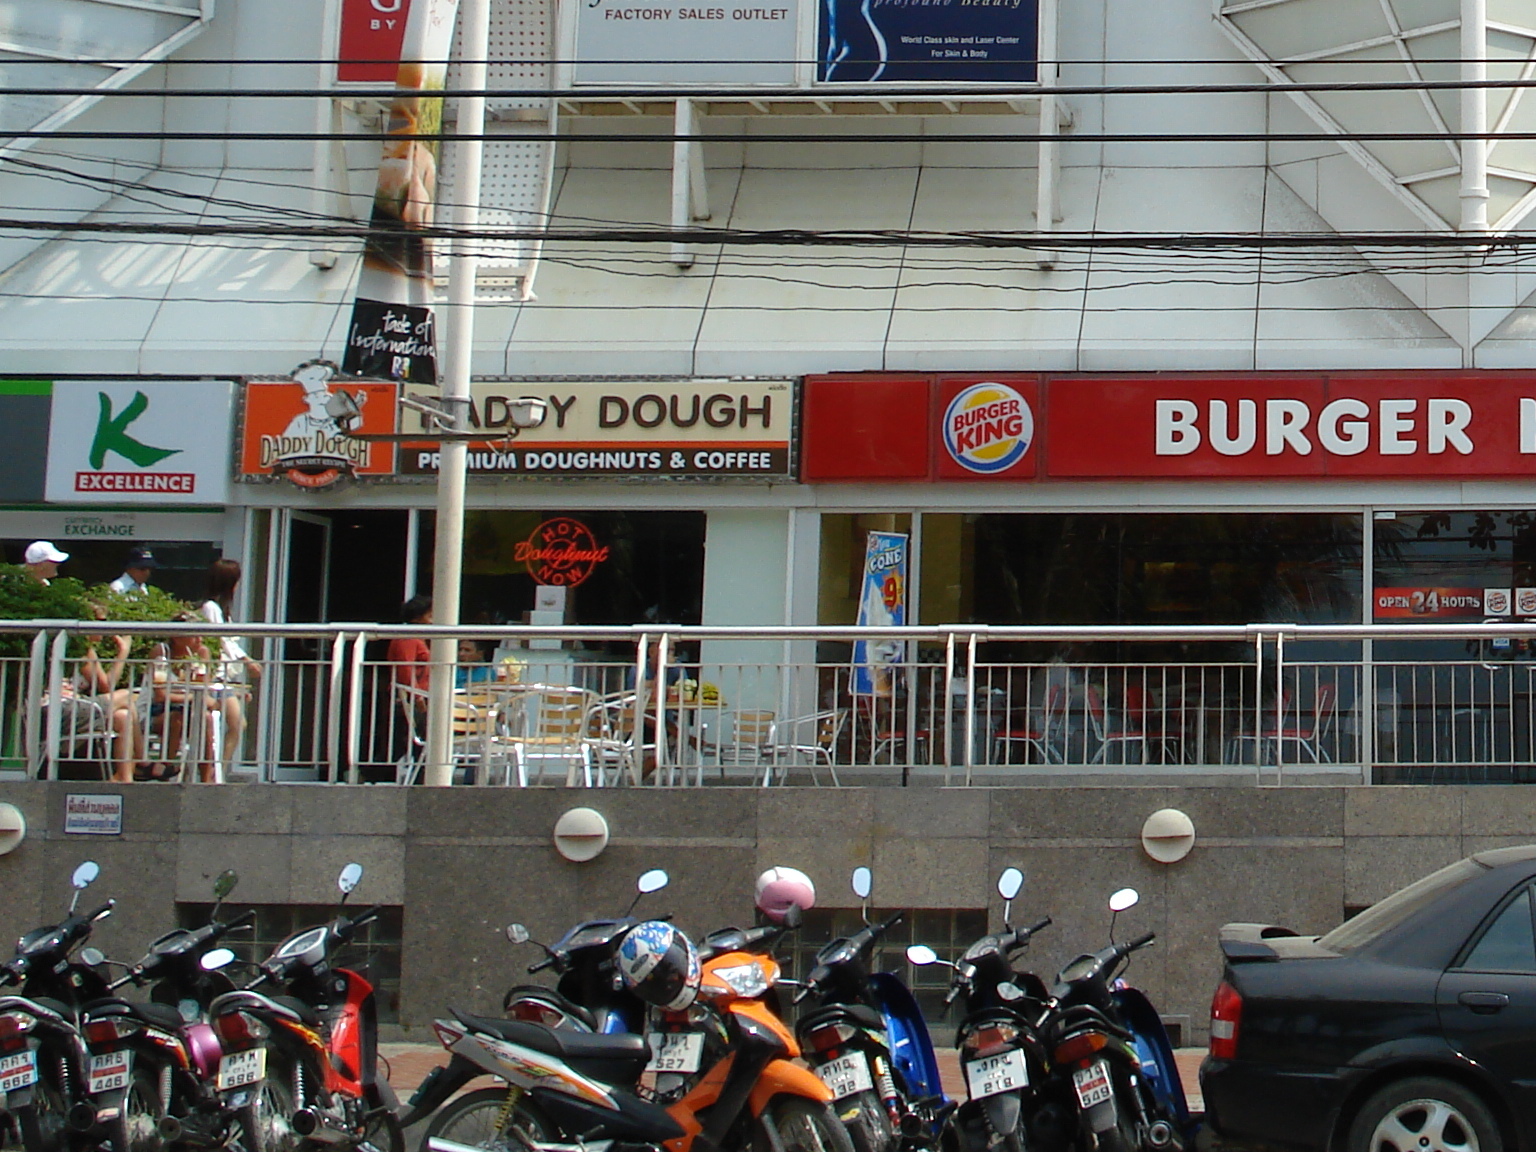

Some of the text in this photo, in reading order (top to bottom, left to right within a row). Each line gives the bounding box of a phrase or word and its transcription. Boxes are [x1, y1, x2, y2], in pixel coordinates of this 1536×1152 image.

[370, 19, 397, 31] BY
[604, 8, 788, 21] FACTORY SALES OUTLET
[900, 35, 1020, 45] World Class skin and Laser Center
[931, 49, 943, 58] For
[944, 49, 961, 59] Skin
[969, 49, 988, 59] Body
[415, 311, 433, 343] of
[600, 394, 772, 429] DOUGH
[953, 399, 1021, 432] BURGER
[88, 390, 184, 471] K
[956, 414, 1024, 455] KING
[1155, 398, 1474, 456] BURGER
[260, 430, 372, 468] DADDY DOUGH
[417, 451, 772, 470] PRMIUM DOUGHNUTS & COFFEE
[77, 474, 193, 491] EXCELLENCE
[64, 524, 136, 536] EXCHANGE
[541, 523, 585, 543] HOT
[513, 540, 611, 569] Doughnut
[869, 548, 903, 573] CONE
[538, 564, 583, 586] NOW
[884, 576, 898, 608] 9
[1379, 591, 1481, 614] OPEN 24 HOURS
[655, 1058, 686, 1070] 527
